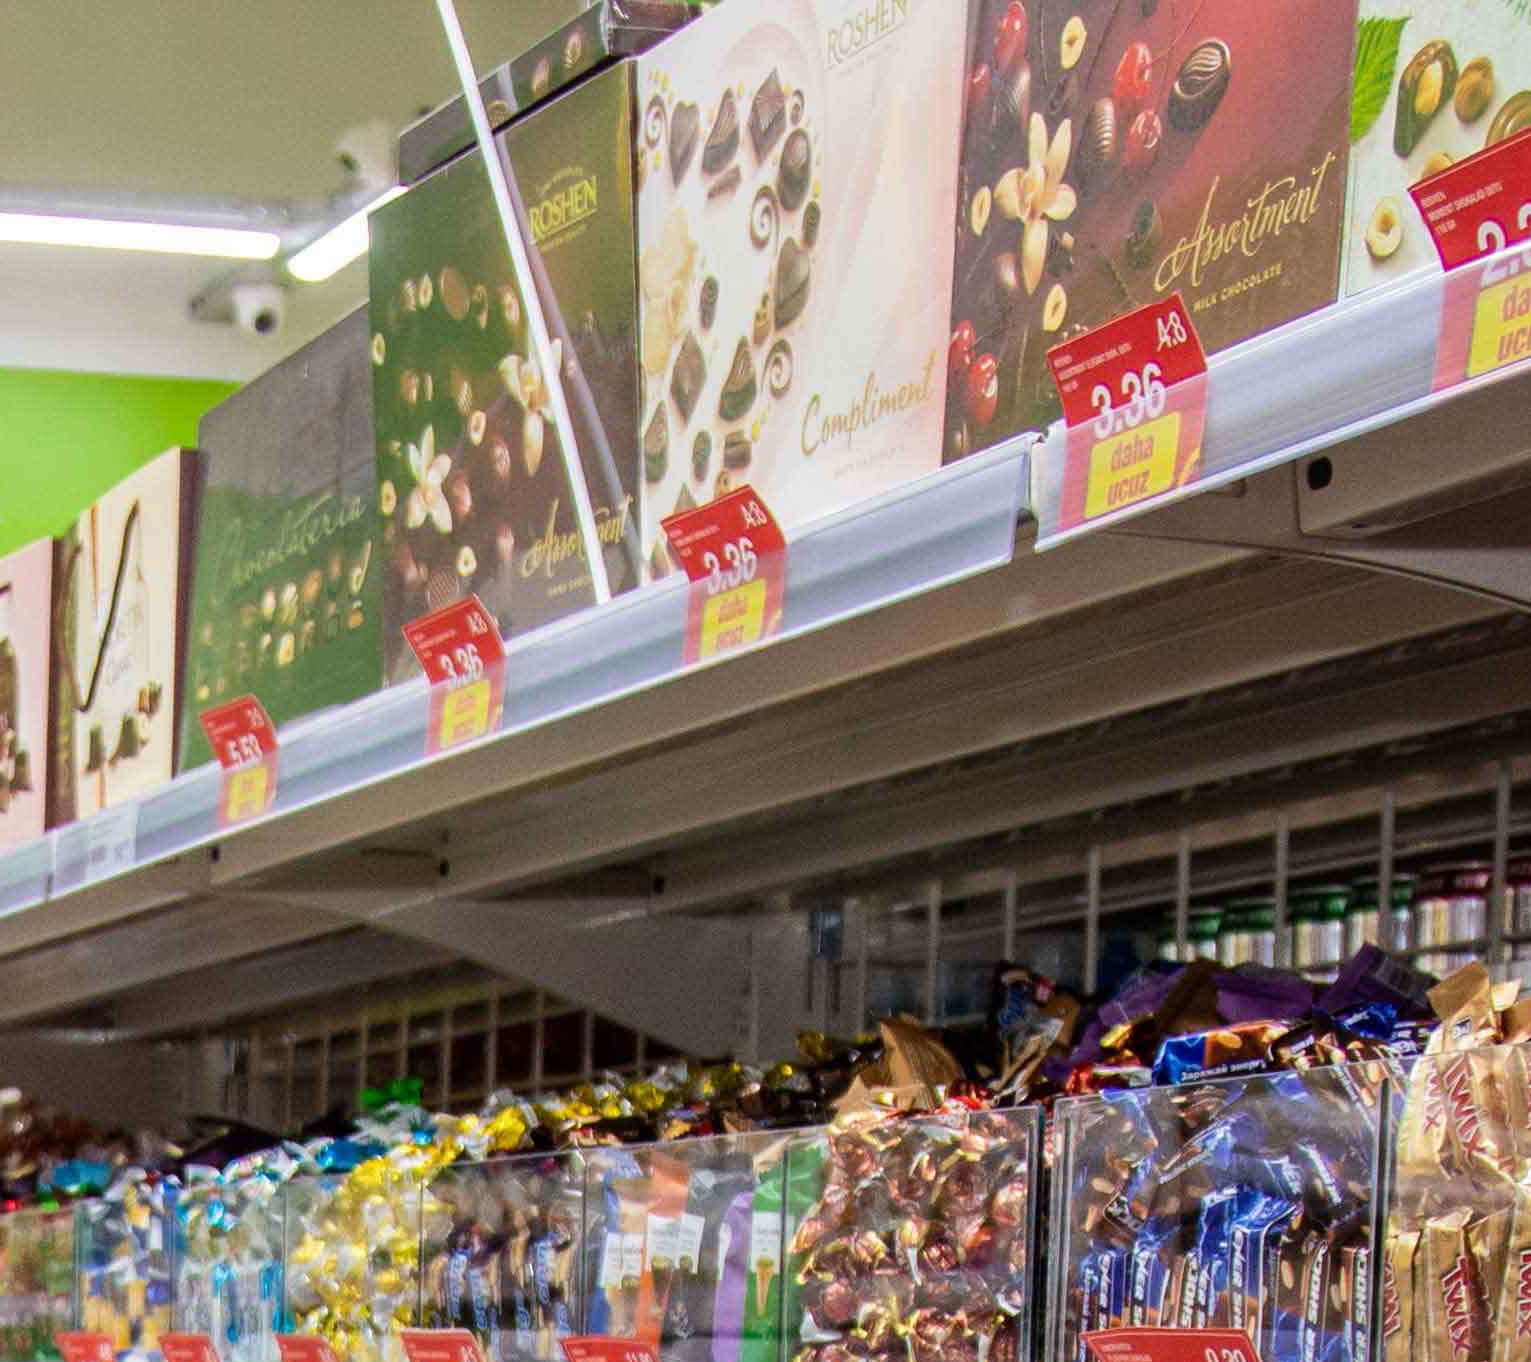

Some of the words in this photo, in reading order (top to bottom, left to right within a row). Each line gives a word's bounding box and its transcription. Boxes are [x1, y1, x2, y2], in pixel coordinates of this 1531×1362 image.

[527, 174, 599, 247] ROSHEN
[1154, 152, 1336, 293] Assortment
[1220, 262, 1283, 304] CHOCOLATE
[801, 348, 937, 457] Compliment
[1090, 361, 1168, 440] 3.36
[1106, 470, 1151, 506] ucuz
[1110, 433, 1155, 470] daha
[701, 536, 759, 596] 3.36
[1445, 1055, 1485, 1164] TWIX
[1441, 1257, 1472, 1354] TWIX
